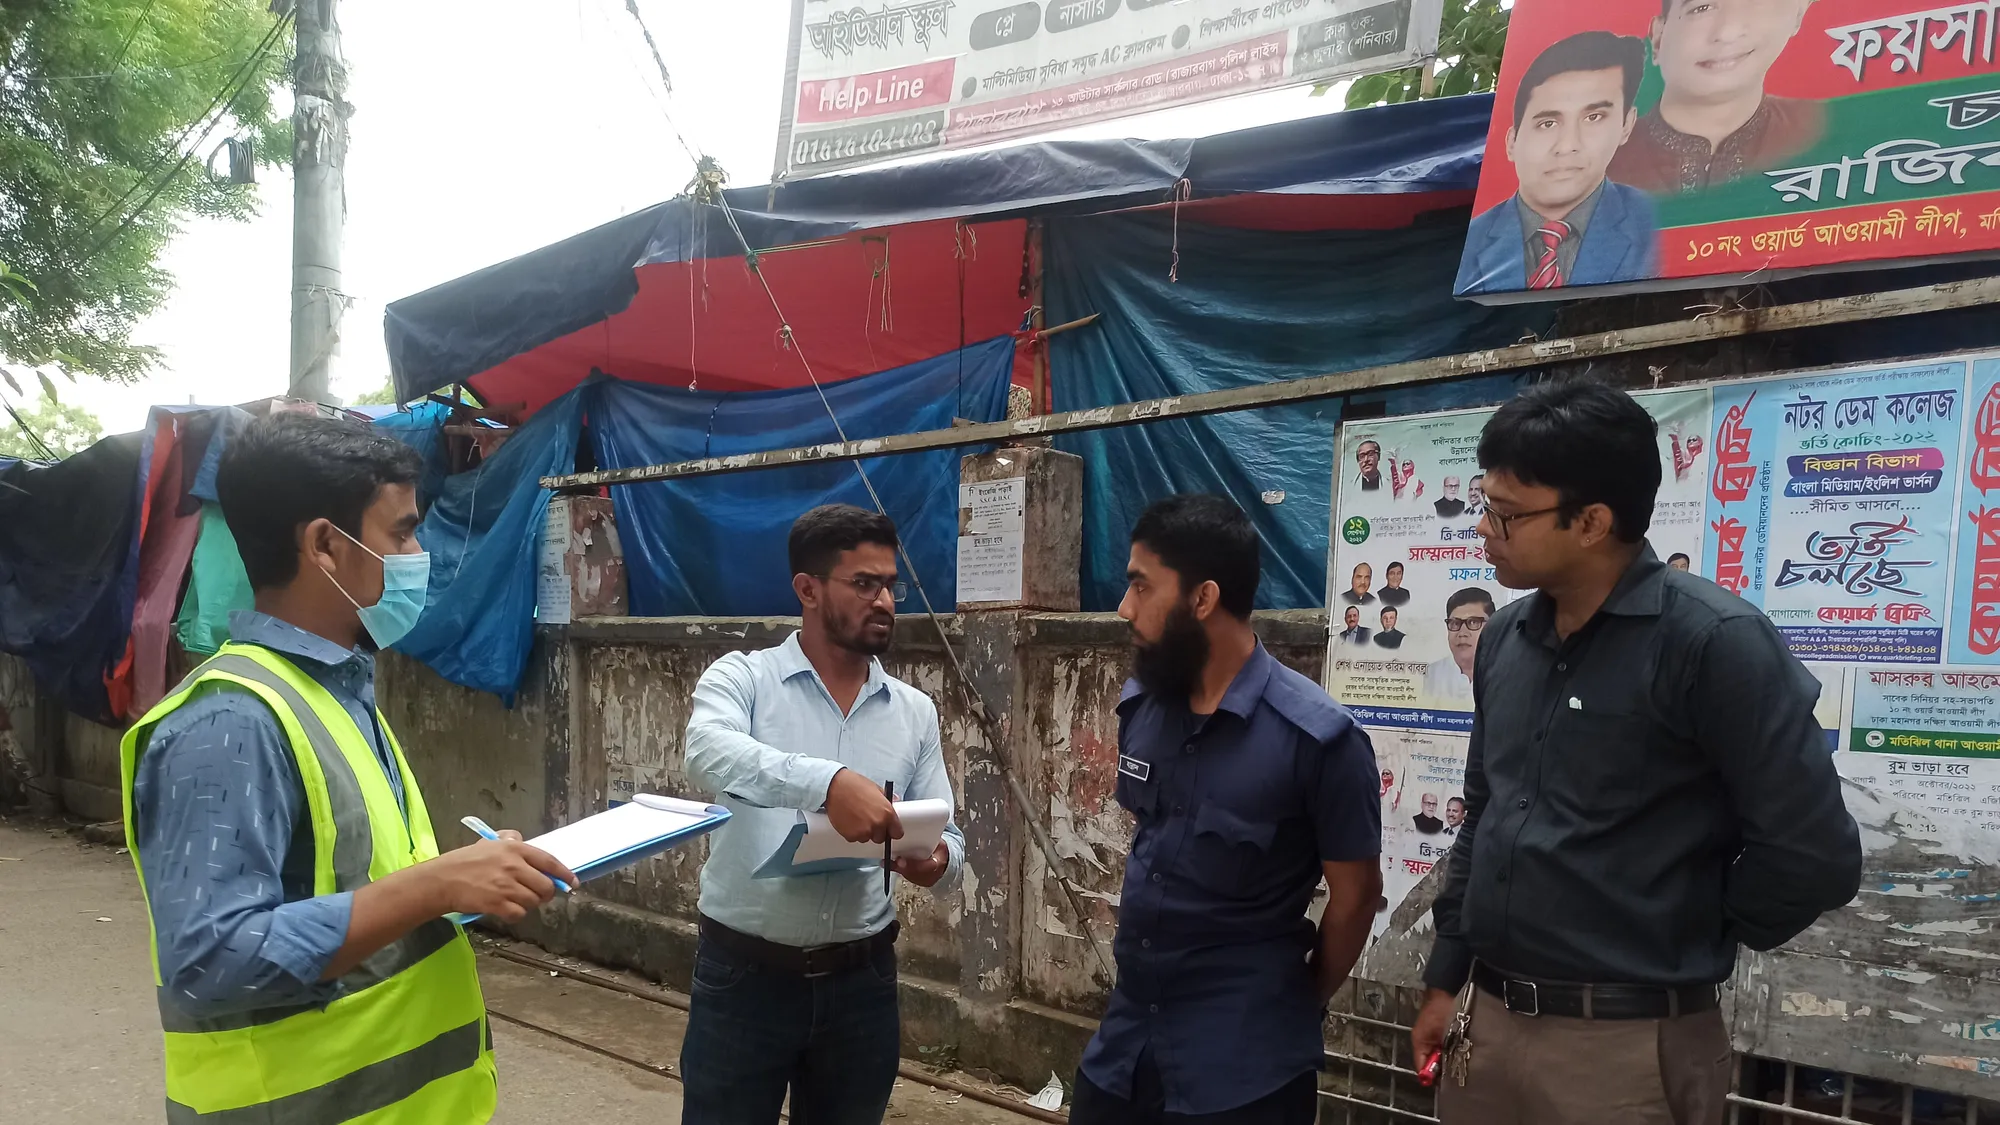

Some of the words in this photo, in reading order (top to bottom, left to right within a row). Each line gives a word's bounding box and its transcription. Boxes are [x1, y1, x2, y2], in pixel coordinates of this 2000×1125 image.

[805, 4, 910, 60] আইডিয়াল
[909, 0, 956, 52] স্কুল
[1039, 59, 1069, 85] সুবিধা
[1100, 47, 1121, 66] AC
[1067, 88, 1100, 105] আউটার
[1140, 72, 1162, 88] রোড
[1219, 52, 1247, 70] পুলিশ
[819, 76, 868, 114] Help
[875, 75, 924, 105] Line
[1750, 218, 1811, 253] ওয়ার্ড
[1813, 207, 1908, 247] আওয়ামী
[1783, 392, 1828, 433] নটর
[1834, 395, 1879, 429] ডেম
[1885, 389, 1957, 425] কলেজ
[1799, 434, 1828, 450] ভর্তি
[1832, 431, 1937, 450] কোচিং-২০২২
[1803, 457, 1860, 474] বিজ্ঞান
[1866, 453, 1923, 470] বিভাগ
[1790, 480, 1818, 494] বাংলা
[1820, 473, 1900, 494] মিডিয়াম/ইংলিশ
[1902, 473, 1934, 489] ভার্সন
[1349, 518, 1363, 530] ১২
[1449, 567, 1481, 581] সফল
[1775, 556, 1934, 596] চলছে
[1817, 604, 1880, 624] কোয়ার্ক
[1883, 602, 1937, 624] ব্রিফিং
[1868, 671, 1935, 688] মাসরুর
[1882, 694, 1908, 703] সাবেক
[1910, 693, 1940, 704] সিনিয়র
[1942, 694, 1994, 706] সহ-সভাপতি
[1376, 710, 1390, 721] থানা
[1391, 710, 1419, 723] আওয়ামী
[1902, 706, 1911, 714] নং
[1914, 705, 1934, 715] ওয়ার্ড
[1935, 706, 1969, 716] আওয়ামী
[1970, 707, 1986, 717] লীগ
[1870, 716, 1888, 725] ঢাকা
[1890, 716, 1921, 726] মহানগর
[1923, 716, 1947, 727] দক্ষিণ
[1949, 718, 1984, 728] আওয়ামী
[1890, 734, 1930, 748] মতিঝিল
[1934, 738, 1957, 750] থানা
[1911, 761, 1941, 775] ভাড়া
[1946, 763, 1970, 776] হবে
[1936, 793, 1970, 804] মতিঝিল
